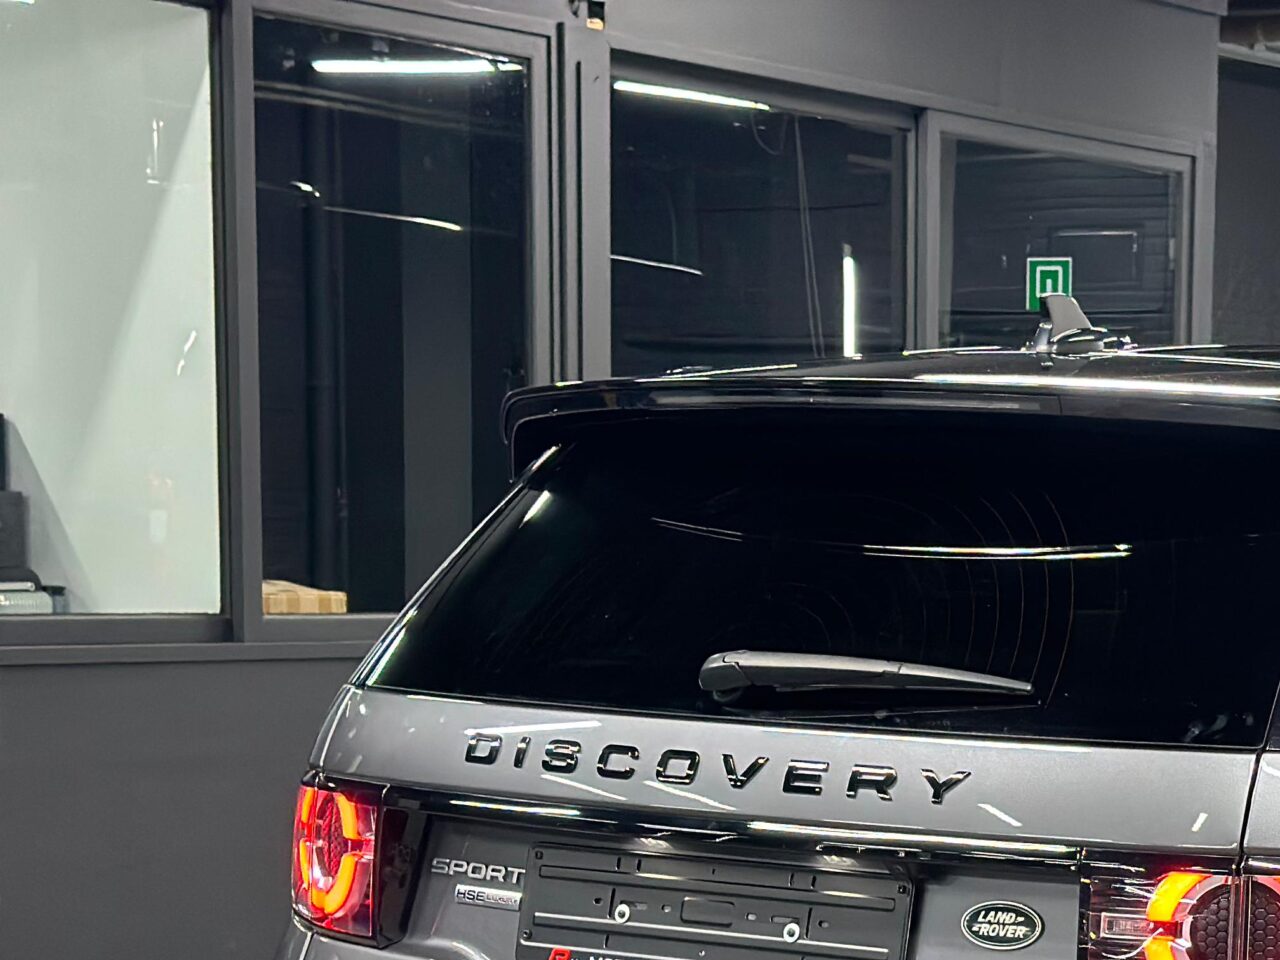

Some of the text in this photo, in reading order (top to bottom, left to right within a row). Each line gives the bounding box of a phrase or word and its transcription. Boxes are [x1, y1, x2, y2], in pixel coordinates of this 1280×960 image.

[463, 731, 972, 805] DISCOVERY
[431, 857, 526, 884] SPORT
[977, 910, 1016, 924] LAND
[979, 924, 1026, 938] ROVER
